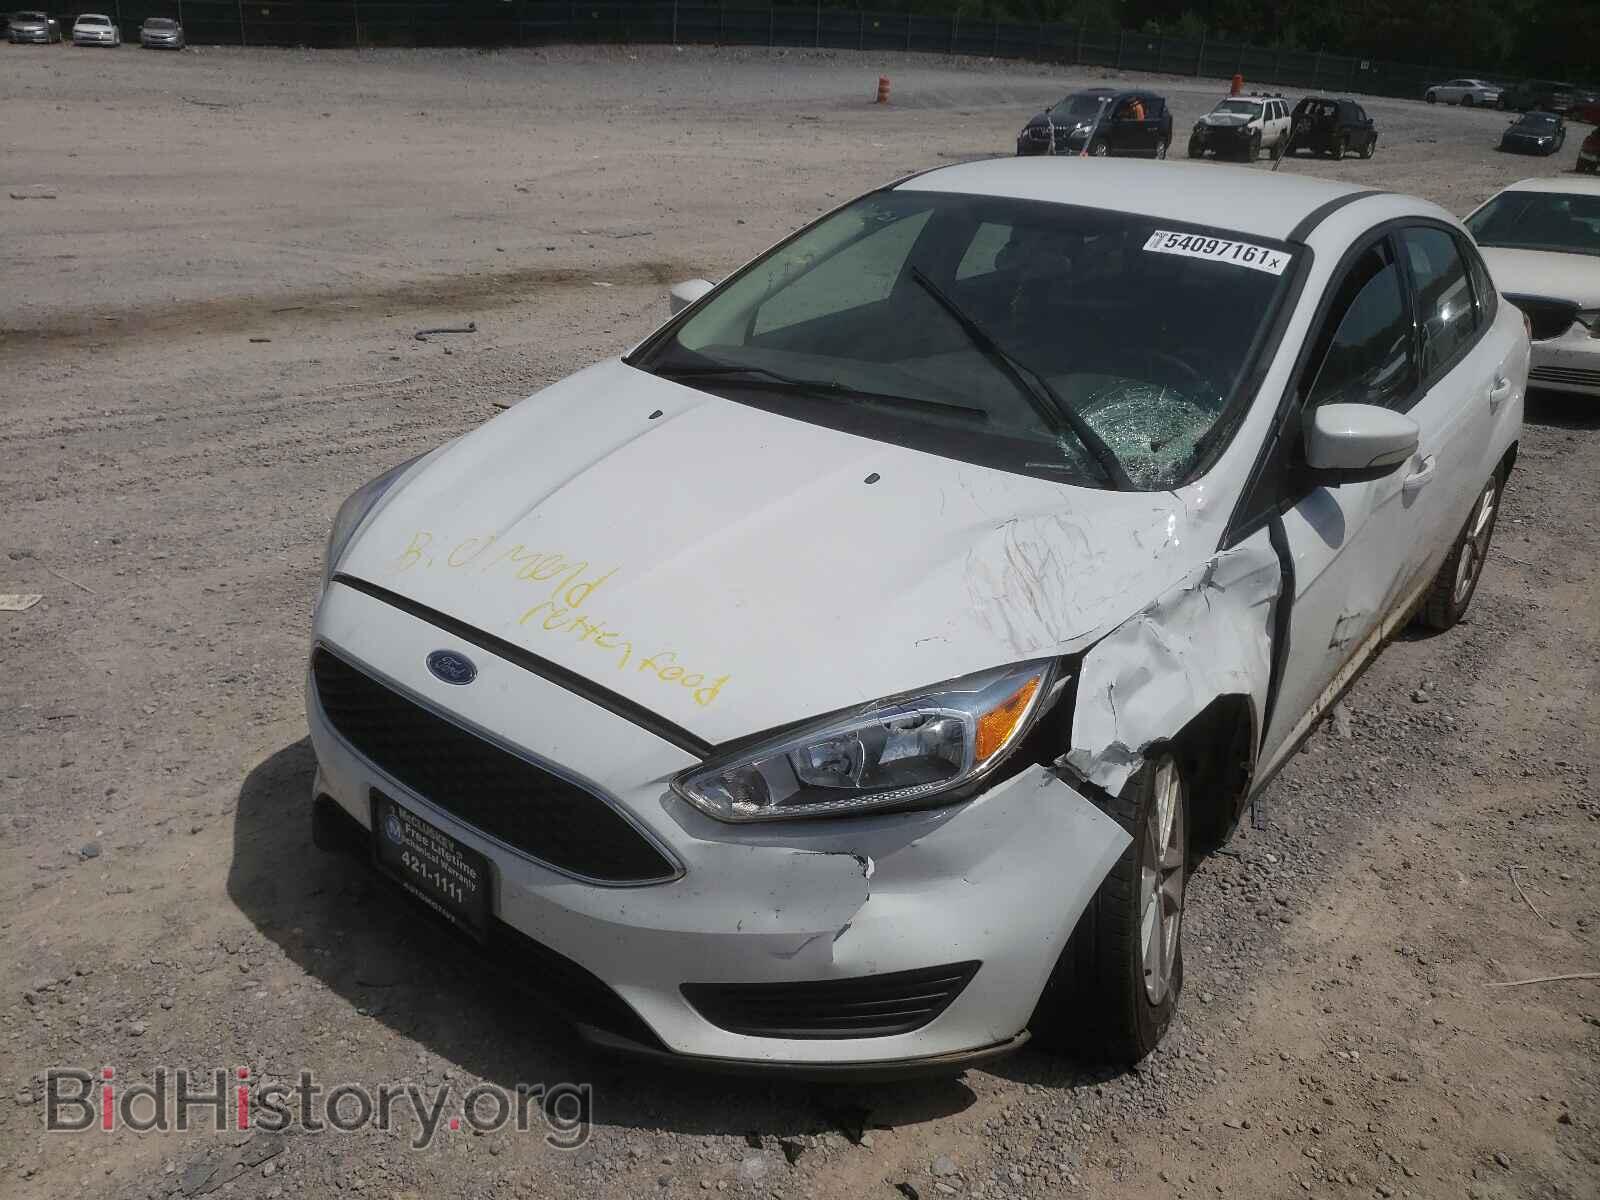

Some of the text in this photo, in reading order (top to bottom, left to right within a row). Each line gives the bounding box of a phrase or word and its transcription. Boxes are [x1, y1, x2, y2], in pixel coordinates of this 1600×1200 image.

[1164, 233, 1270, 265] 54097161
[401, 850, 463, 903] 421-1111
[405, 823, 478, 880] Free Lifetime
